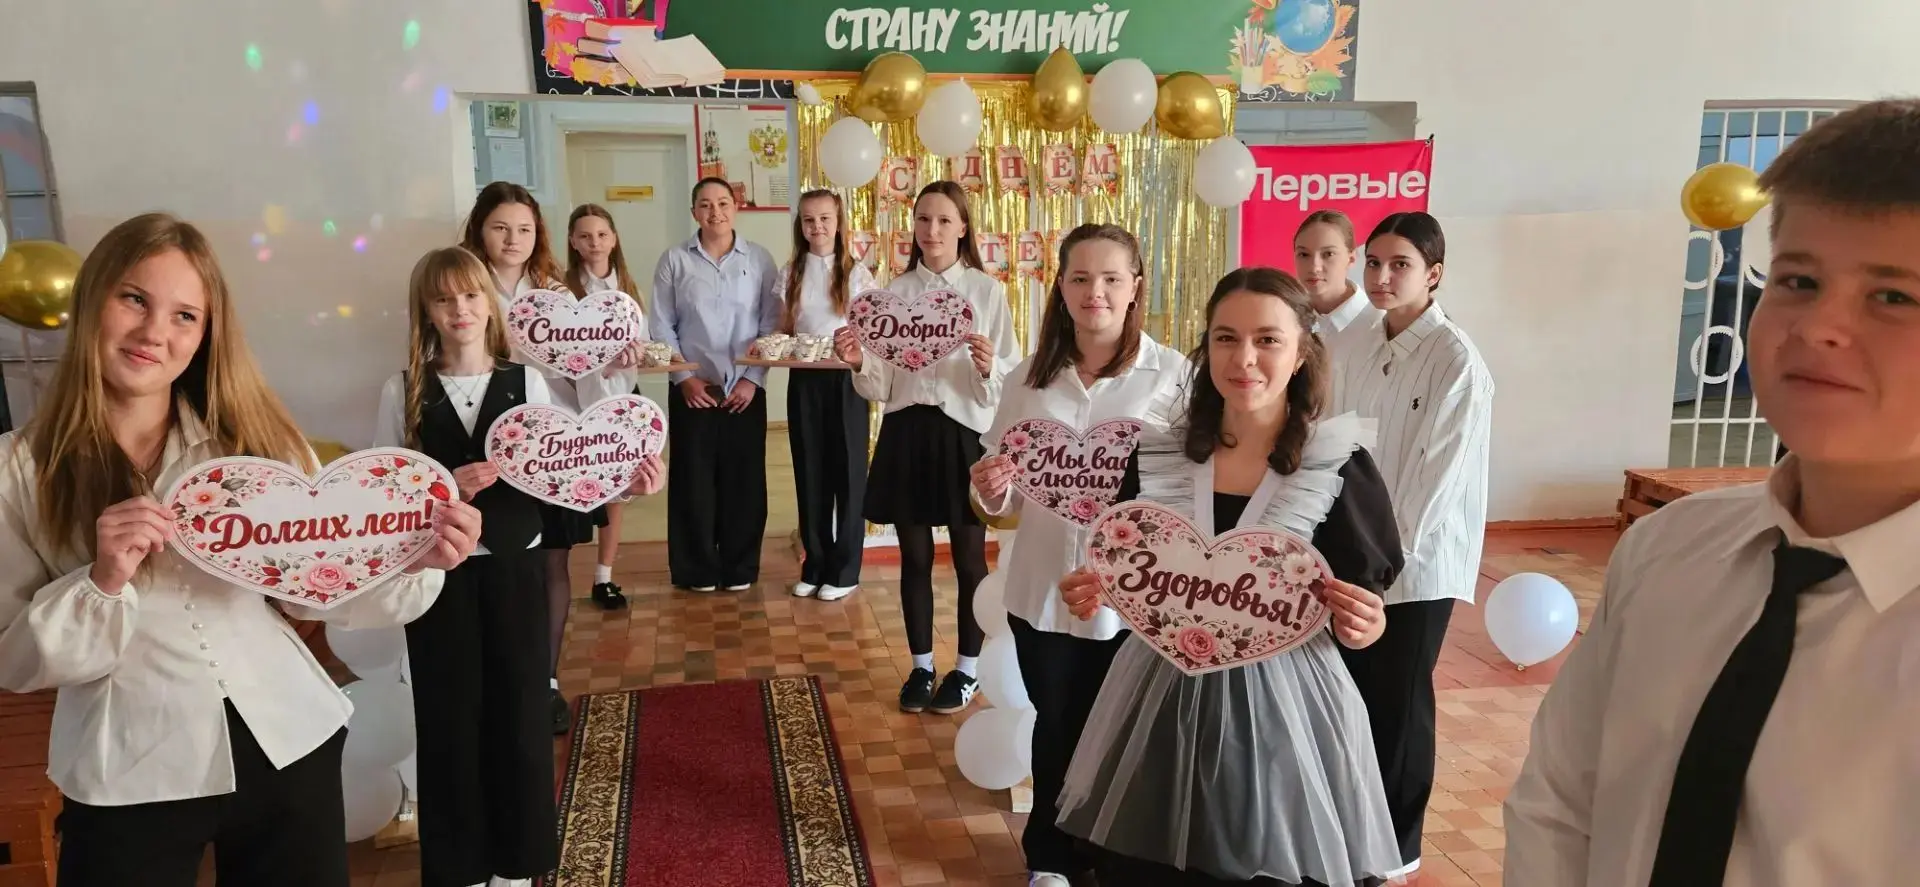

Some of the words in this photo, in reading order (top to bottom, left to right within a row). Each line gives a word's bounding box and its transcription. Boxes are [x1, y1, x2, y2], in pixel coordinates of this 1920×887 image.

[825, 7, 961, 53] СТРАНУ
[966, 3, 1130, 55] ЗНАНИЙ!
[889, 166, 909, 192] С
[960, 150, 1112, 182] ДНЁМ
[528, 317, 632, 345] Спасибо!
[868, 314, 957, 343] Добра!
[523, 439, 648, 476] счастливы!
[537, 429, 625, 459] Будьте
[1027, 445, 1088, 472] Мы
[209, 513, 352, 553] Долгих
[356, 499, 434, 538] лет!
[1118, 551, 1311, 632] Здоровья!
